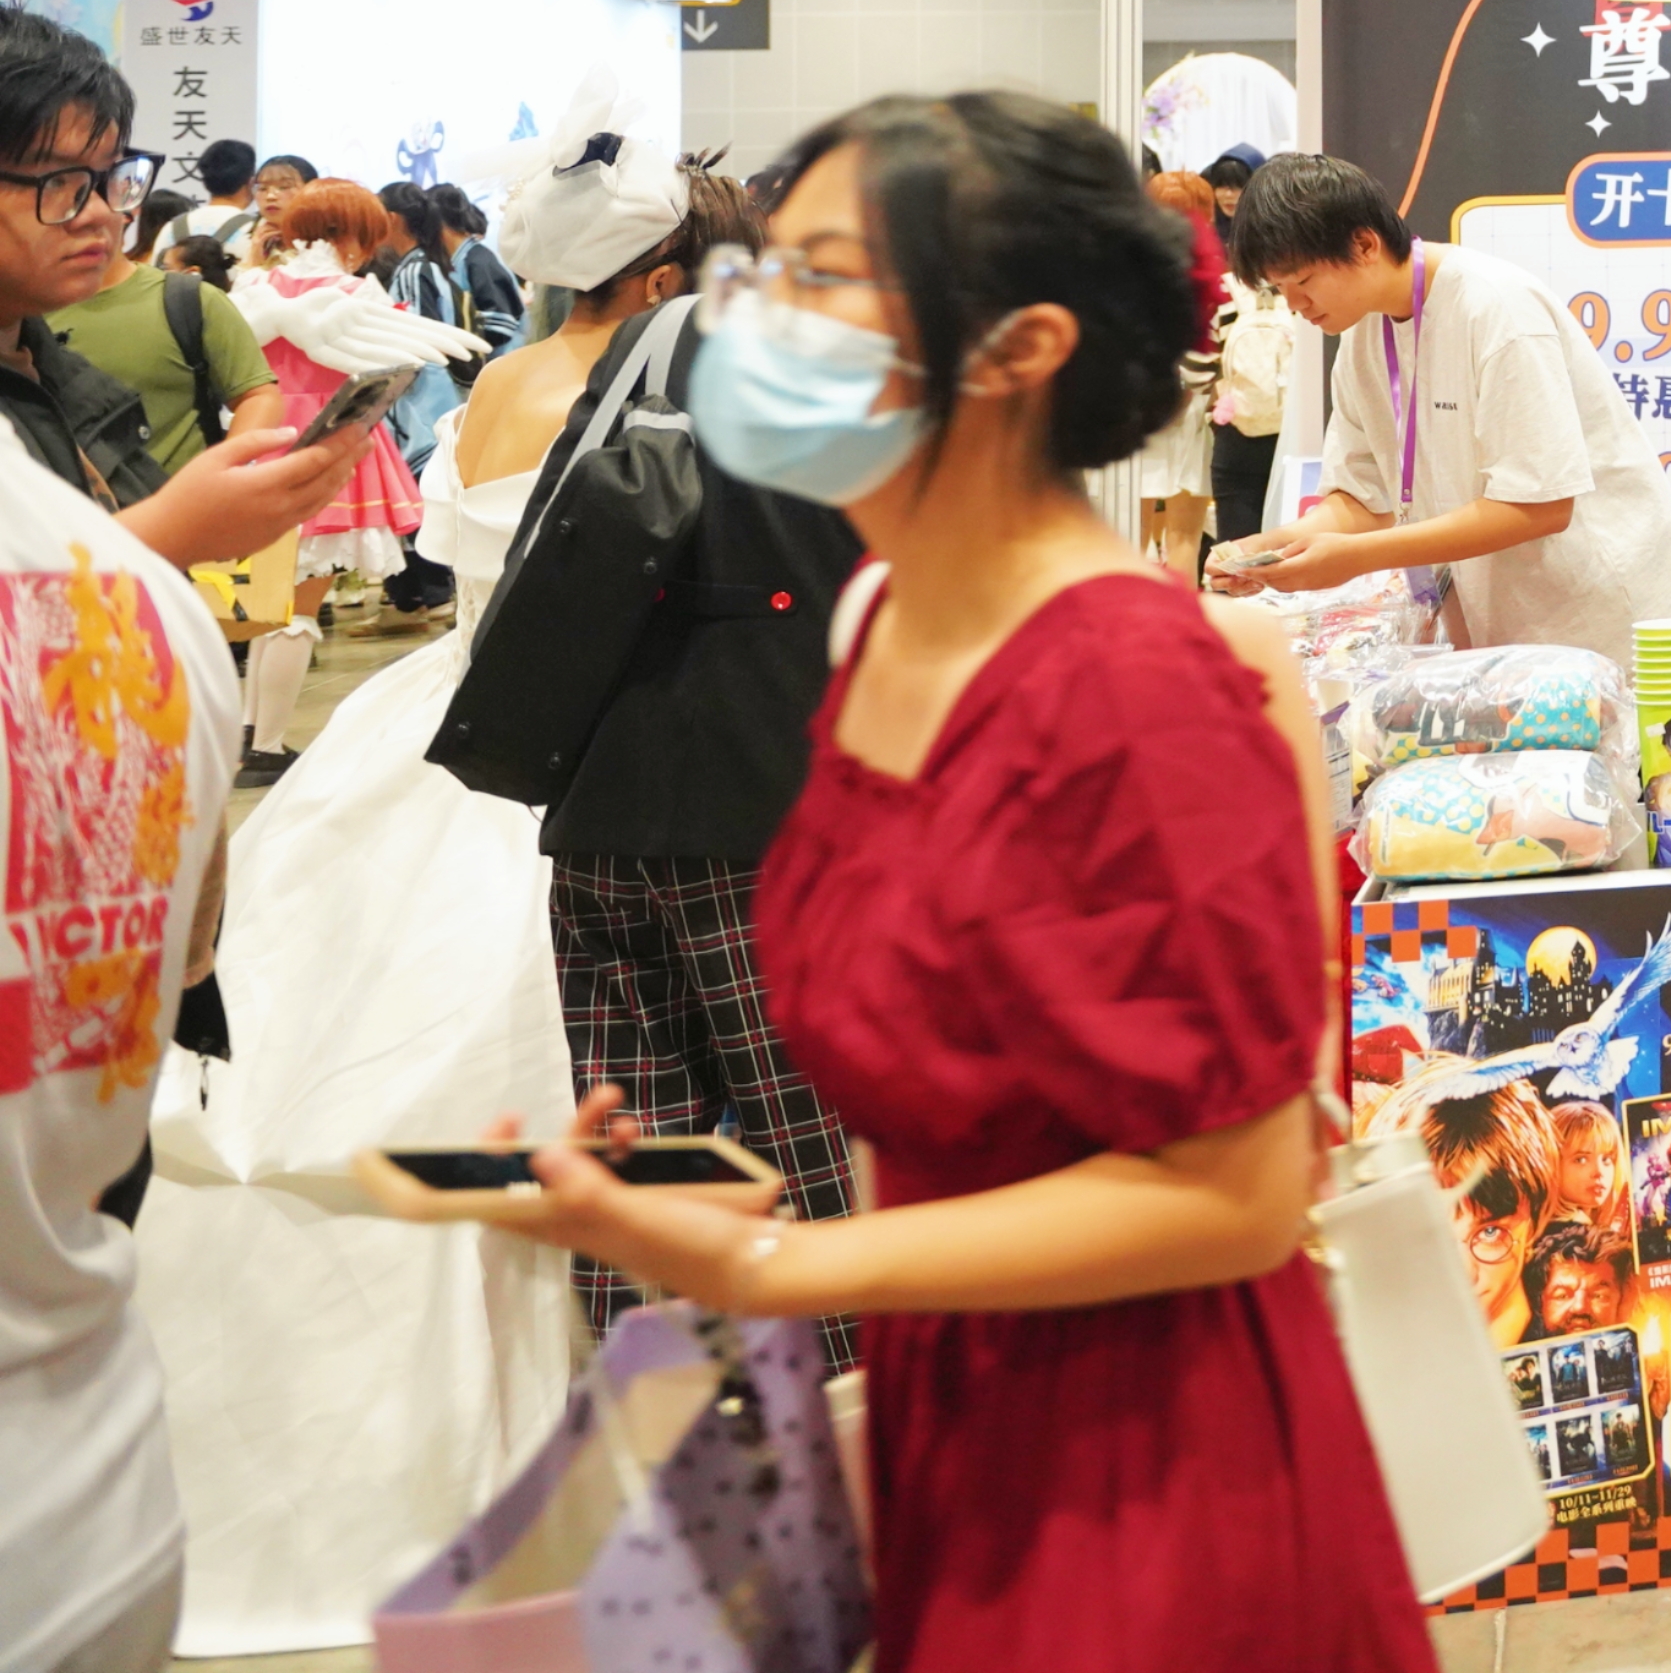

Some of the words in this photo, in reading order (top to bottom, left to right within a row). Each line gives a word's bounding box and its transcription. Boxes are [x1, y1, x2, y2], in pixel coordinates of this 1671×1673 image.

[140, 26, 242, 46] 盛世友天
[171, 65, 209, 210] 友天文
